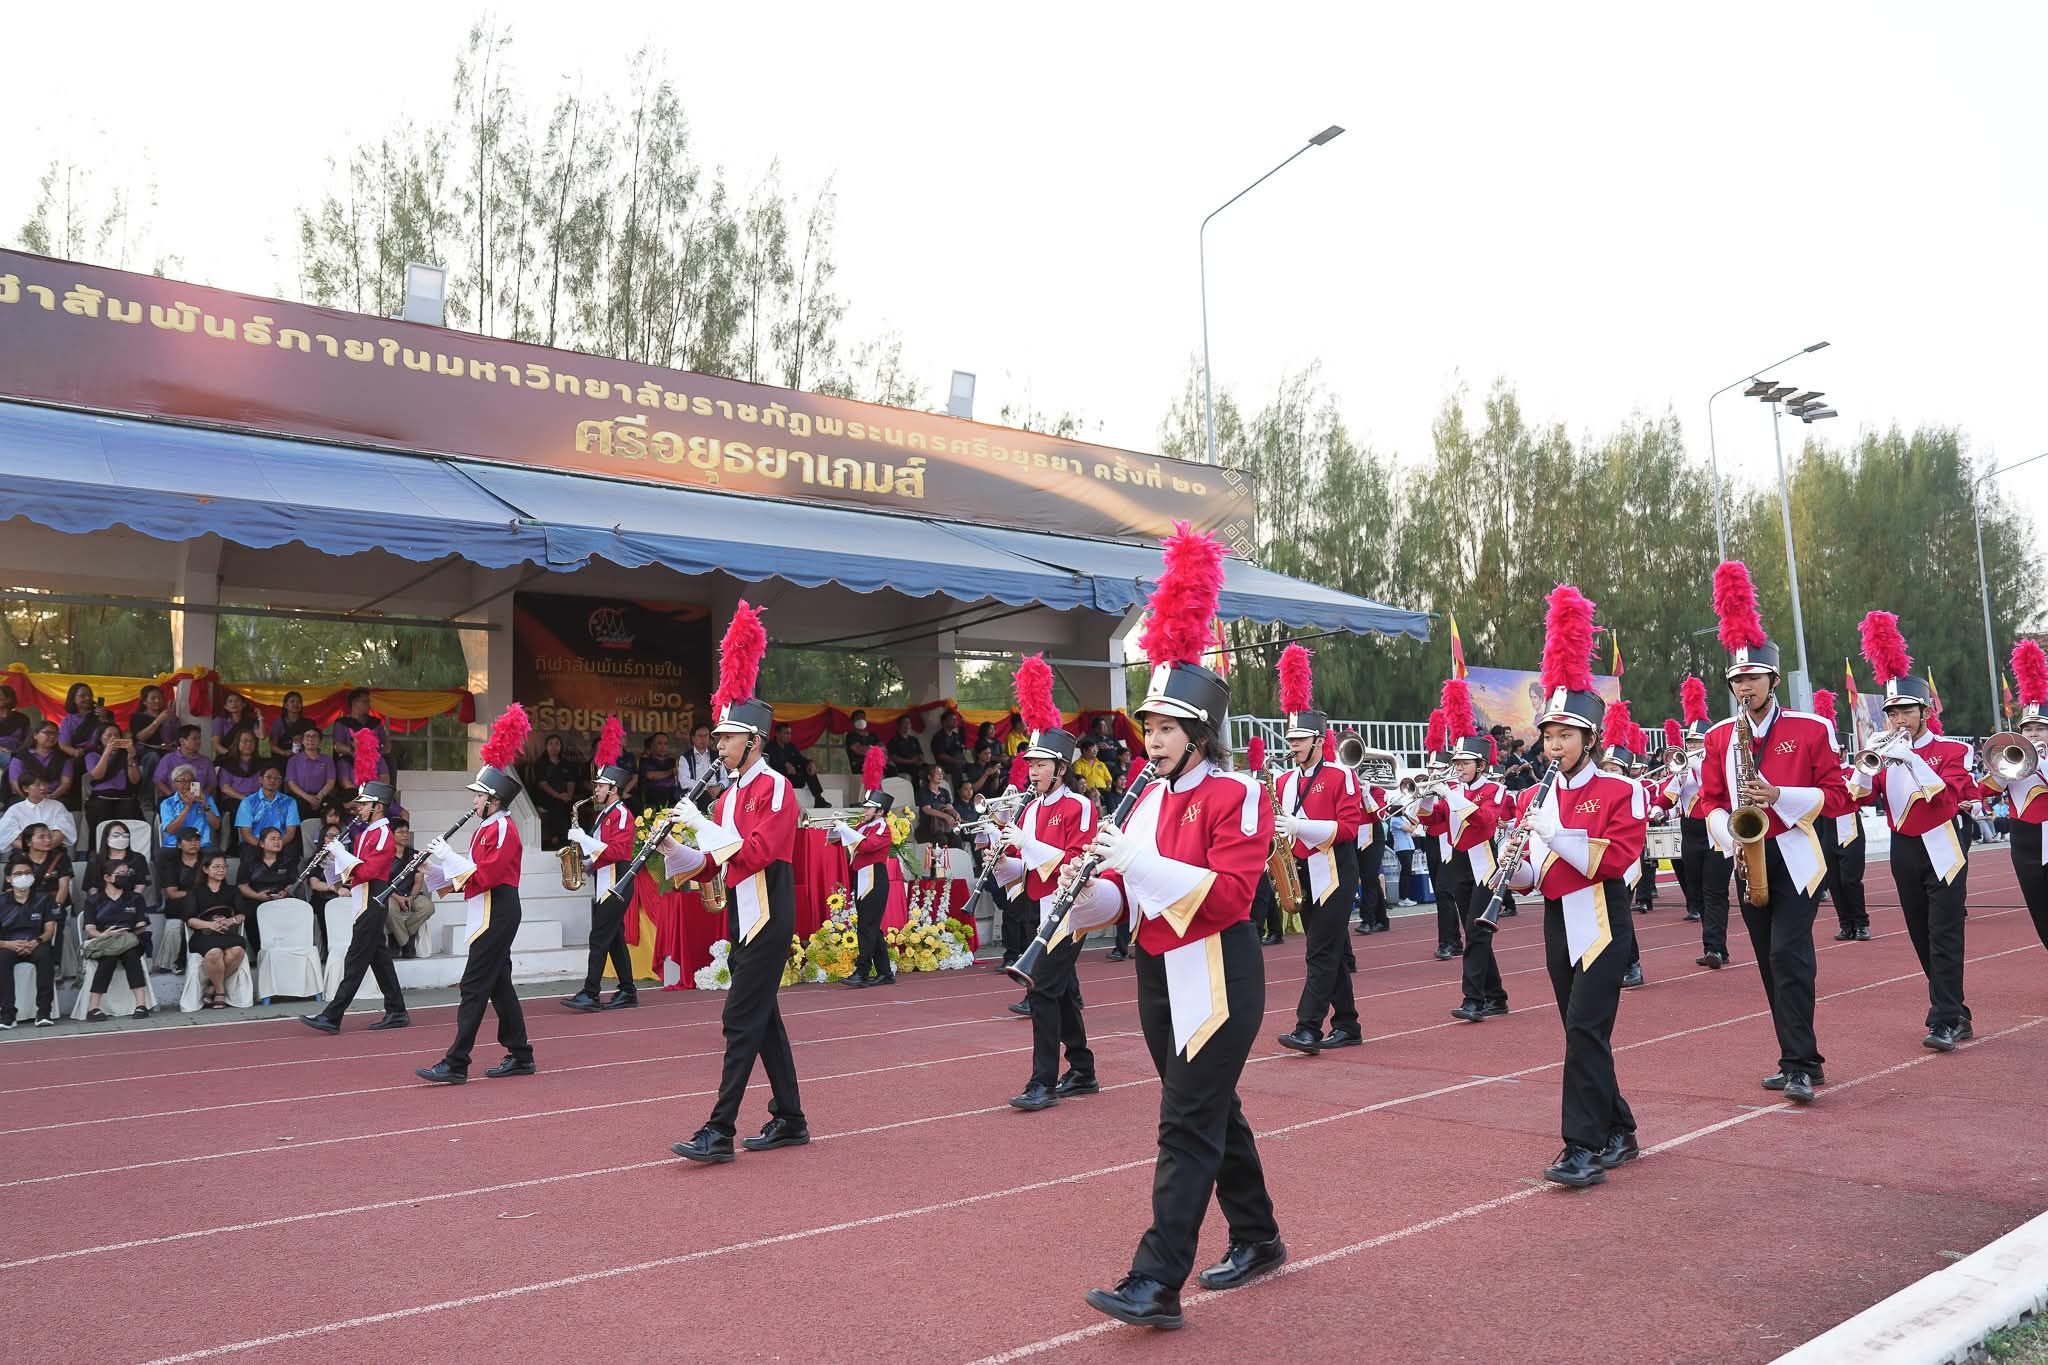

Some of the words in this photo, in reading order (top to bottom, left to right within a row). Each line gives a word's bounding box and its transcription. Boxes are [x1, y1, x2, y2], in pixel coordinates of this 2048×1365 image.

[575, 414, 927, 498] ศรีอยุธยาเกมส์
[1094, 456, 1162, 489] ครั้งที่
[648, 689, 682, 708] ๒๐
